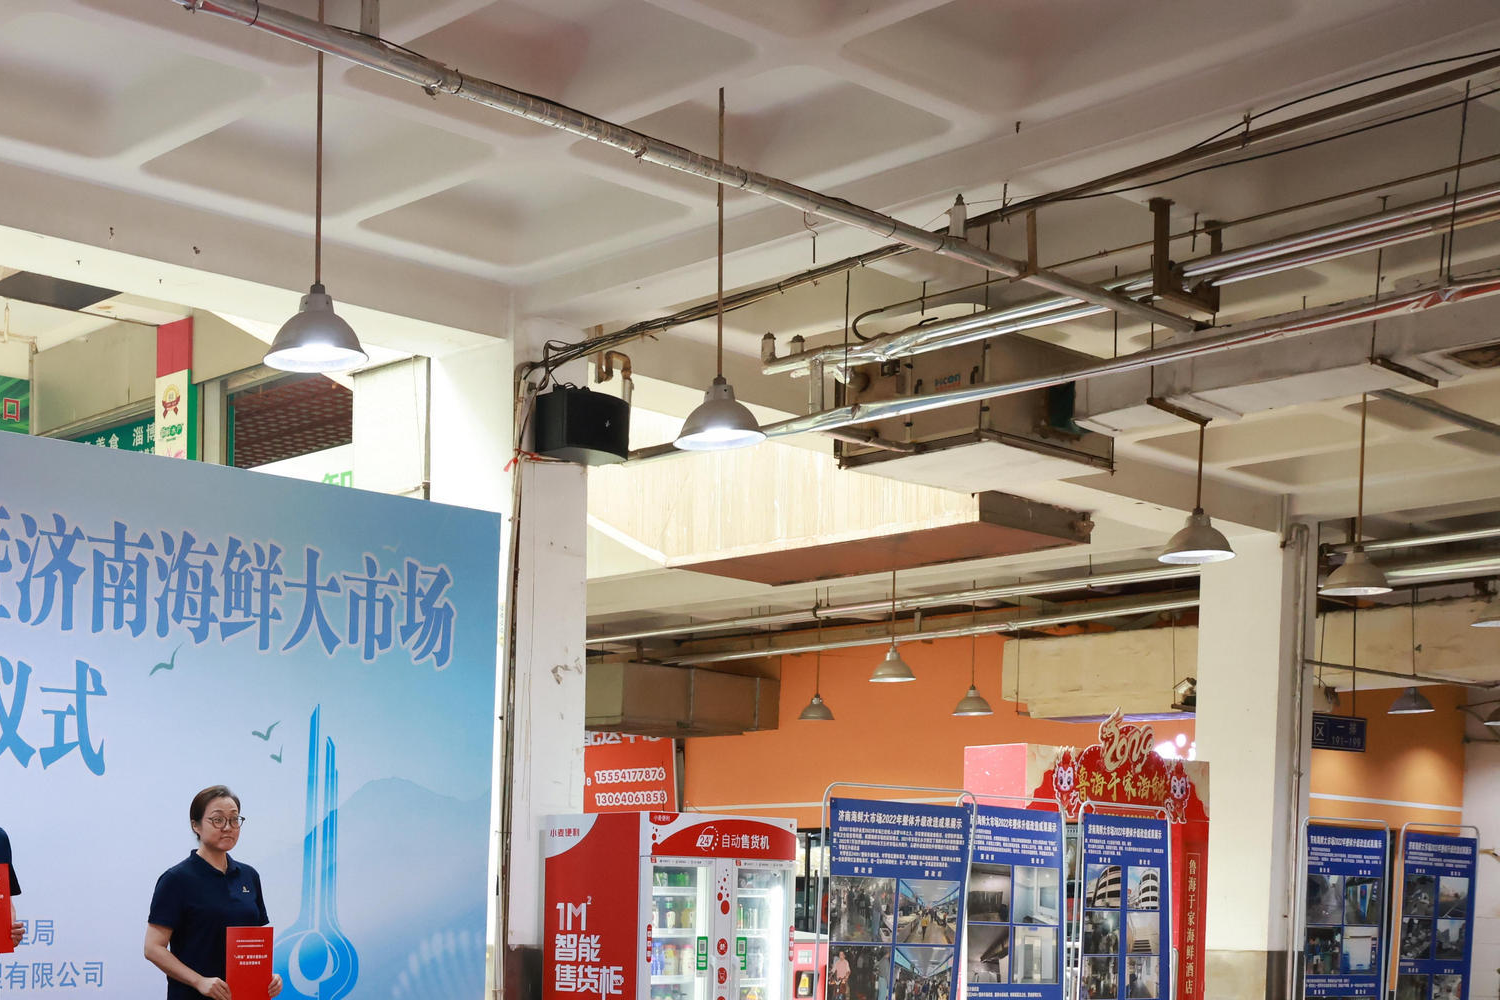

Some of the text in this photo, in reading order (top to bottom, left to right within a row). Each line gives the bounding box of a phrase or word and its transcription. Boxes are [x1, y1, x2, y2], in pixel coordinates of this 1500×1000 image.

[594, 767, 666, 784] 15554177876
[594, 790, 668, 806] 13064061858
[720, 834, 770, 850] 自动售货机
[554, 933, 601, 962] 智能
